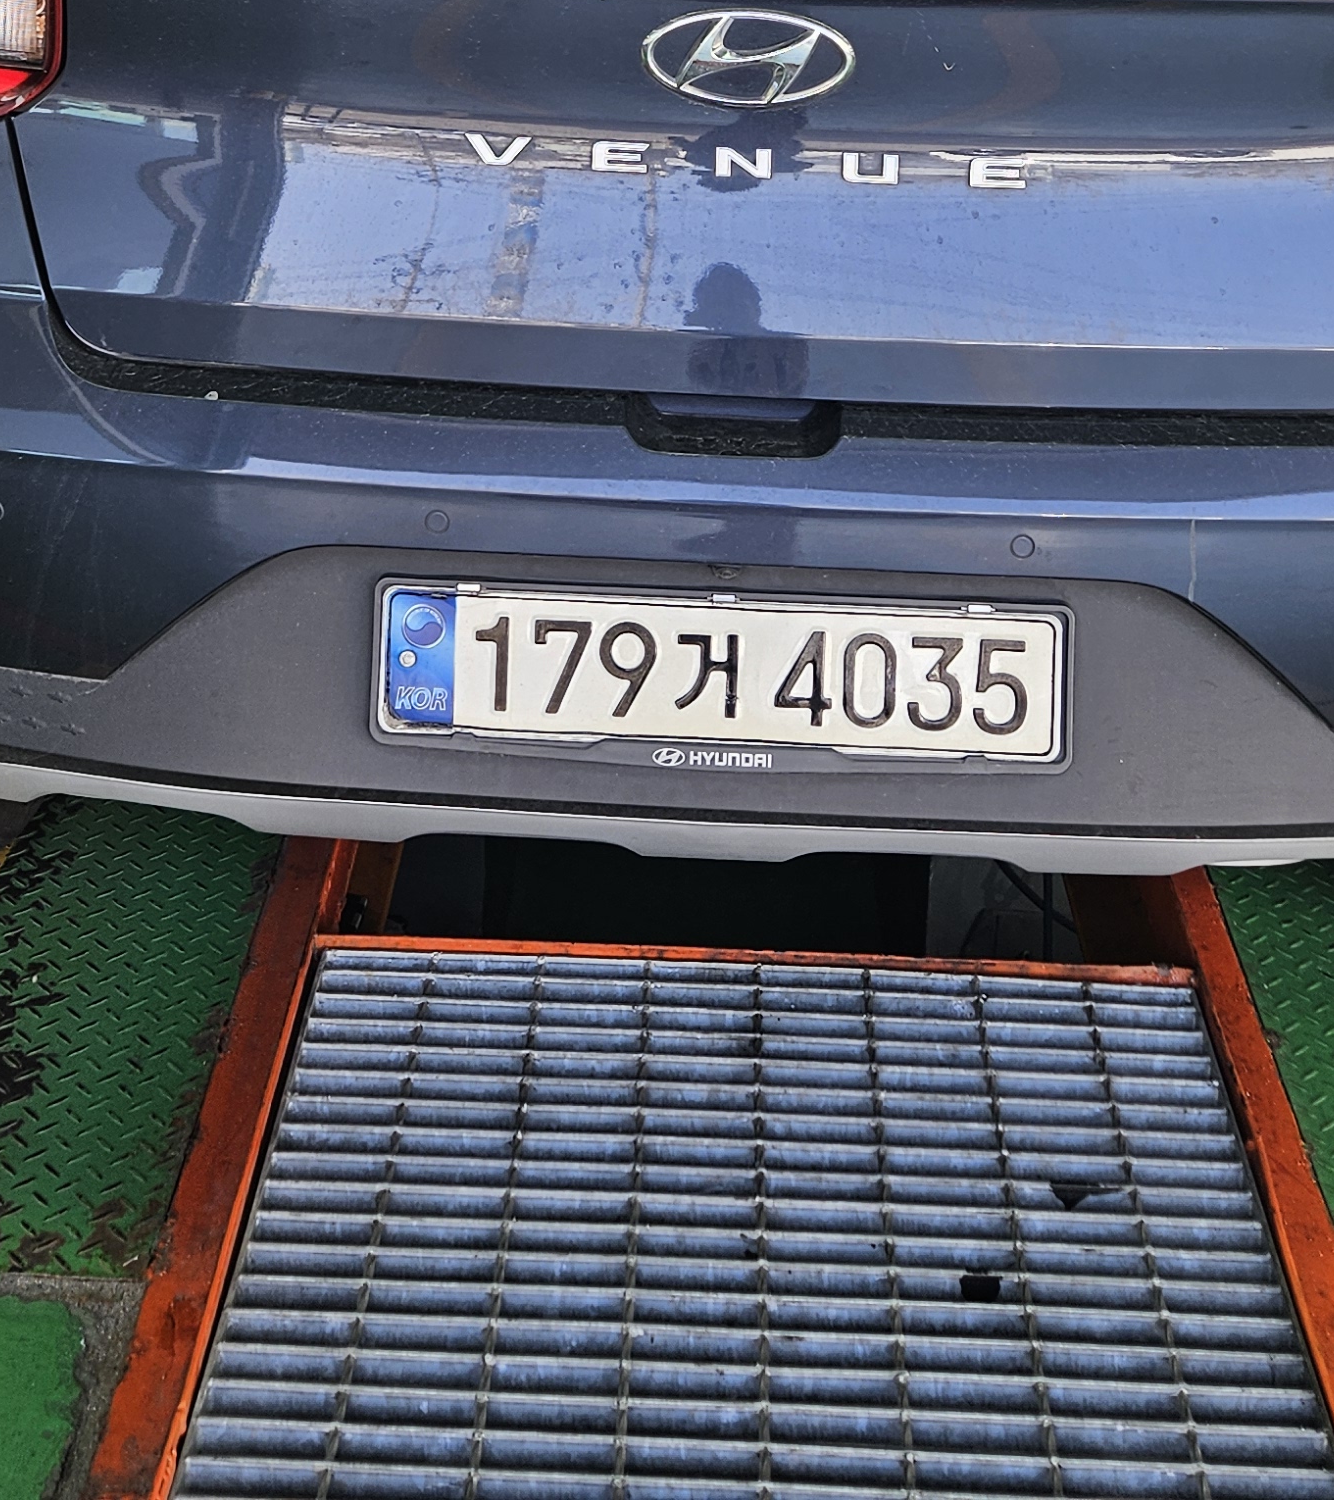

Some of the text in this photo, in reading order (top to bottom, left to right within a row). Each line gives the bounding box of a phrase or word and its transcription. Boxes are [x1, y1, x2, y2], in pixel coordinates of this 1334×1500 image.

[464, 132, 1028, 190] VENUE
[475, 616, 1028, 735] 179거 4035
[394, 686, 448, 710] KOR
[688, 750, 773, 770] HYUNDAI
